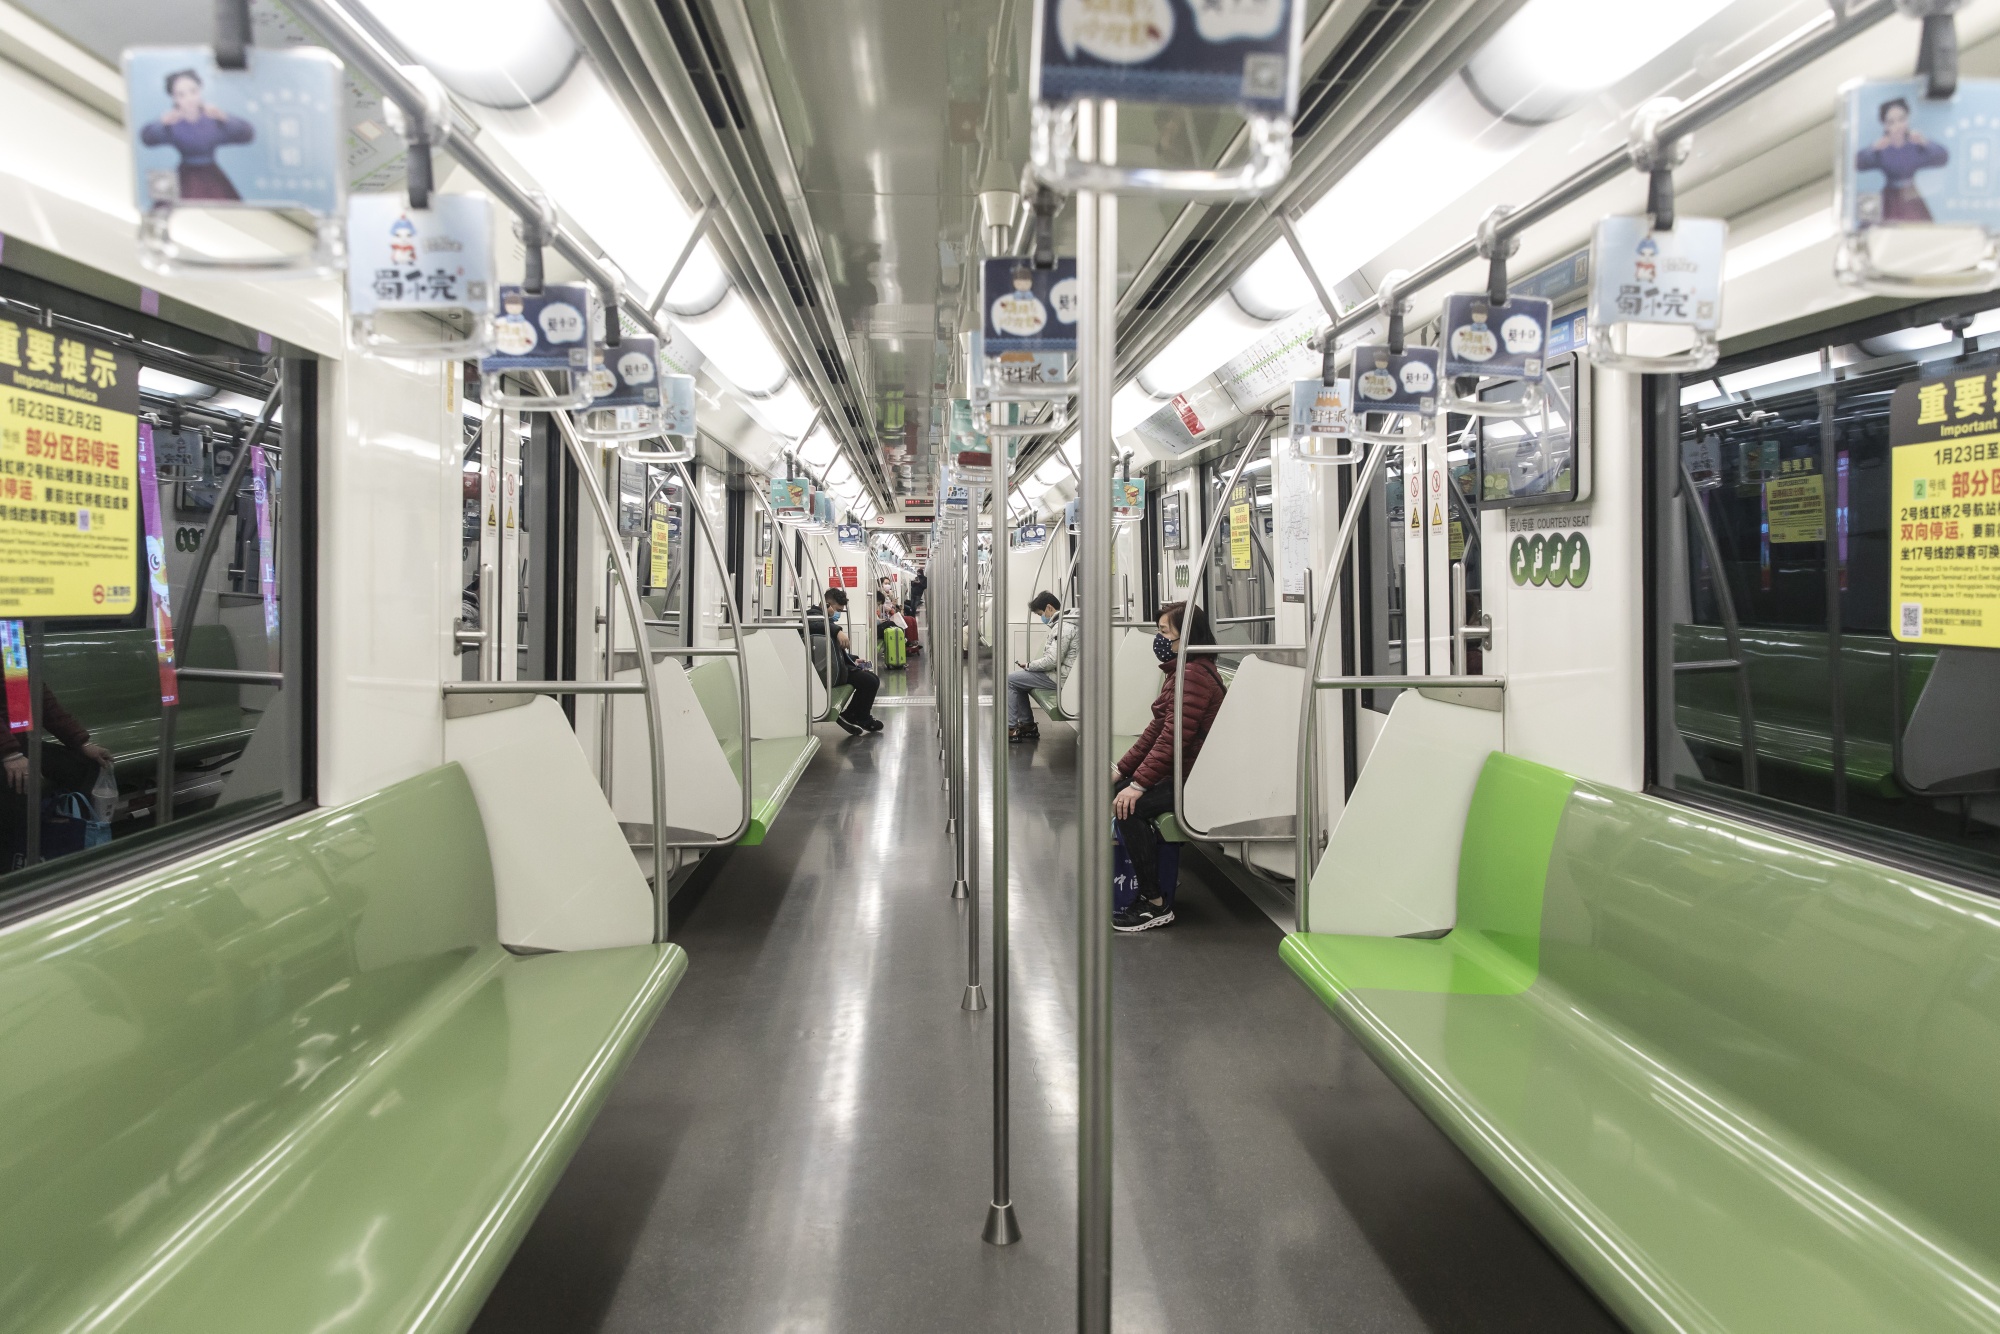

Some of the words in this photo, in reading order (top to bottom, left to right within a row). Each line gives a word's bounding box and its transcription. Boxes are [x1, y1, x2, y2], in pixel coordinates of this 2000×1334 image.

[13, 370, 66, 395] Important
[66, 383, 98, 402] Notice
[9, 396, 103, 432] 1月23日至2月2日
[1941, 418, 1998, 437] Important
[26, 427, 119, 470] 部分区段停运
[1934, 442, 1999, 466] 1月23日至
[1537, 517, 1570, 529] COURTESY
[1572, 515, 1590, 527] SEAT
[1901, 501, 2000, 521] 2号线虹桥2号航站
